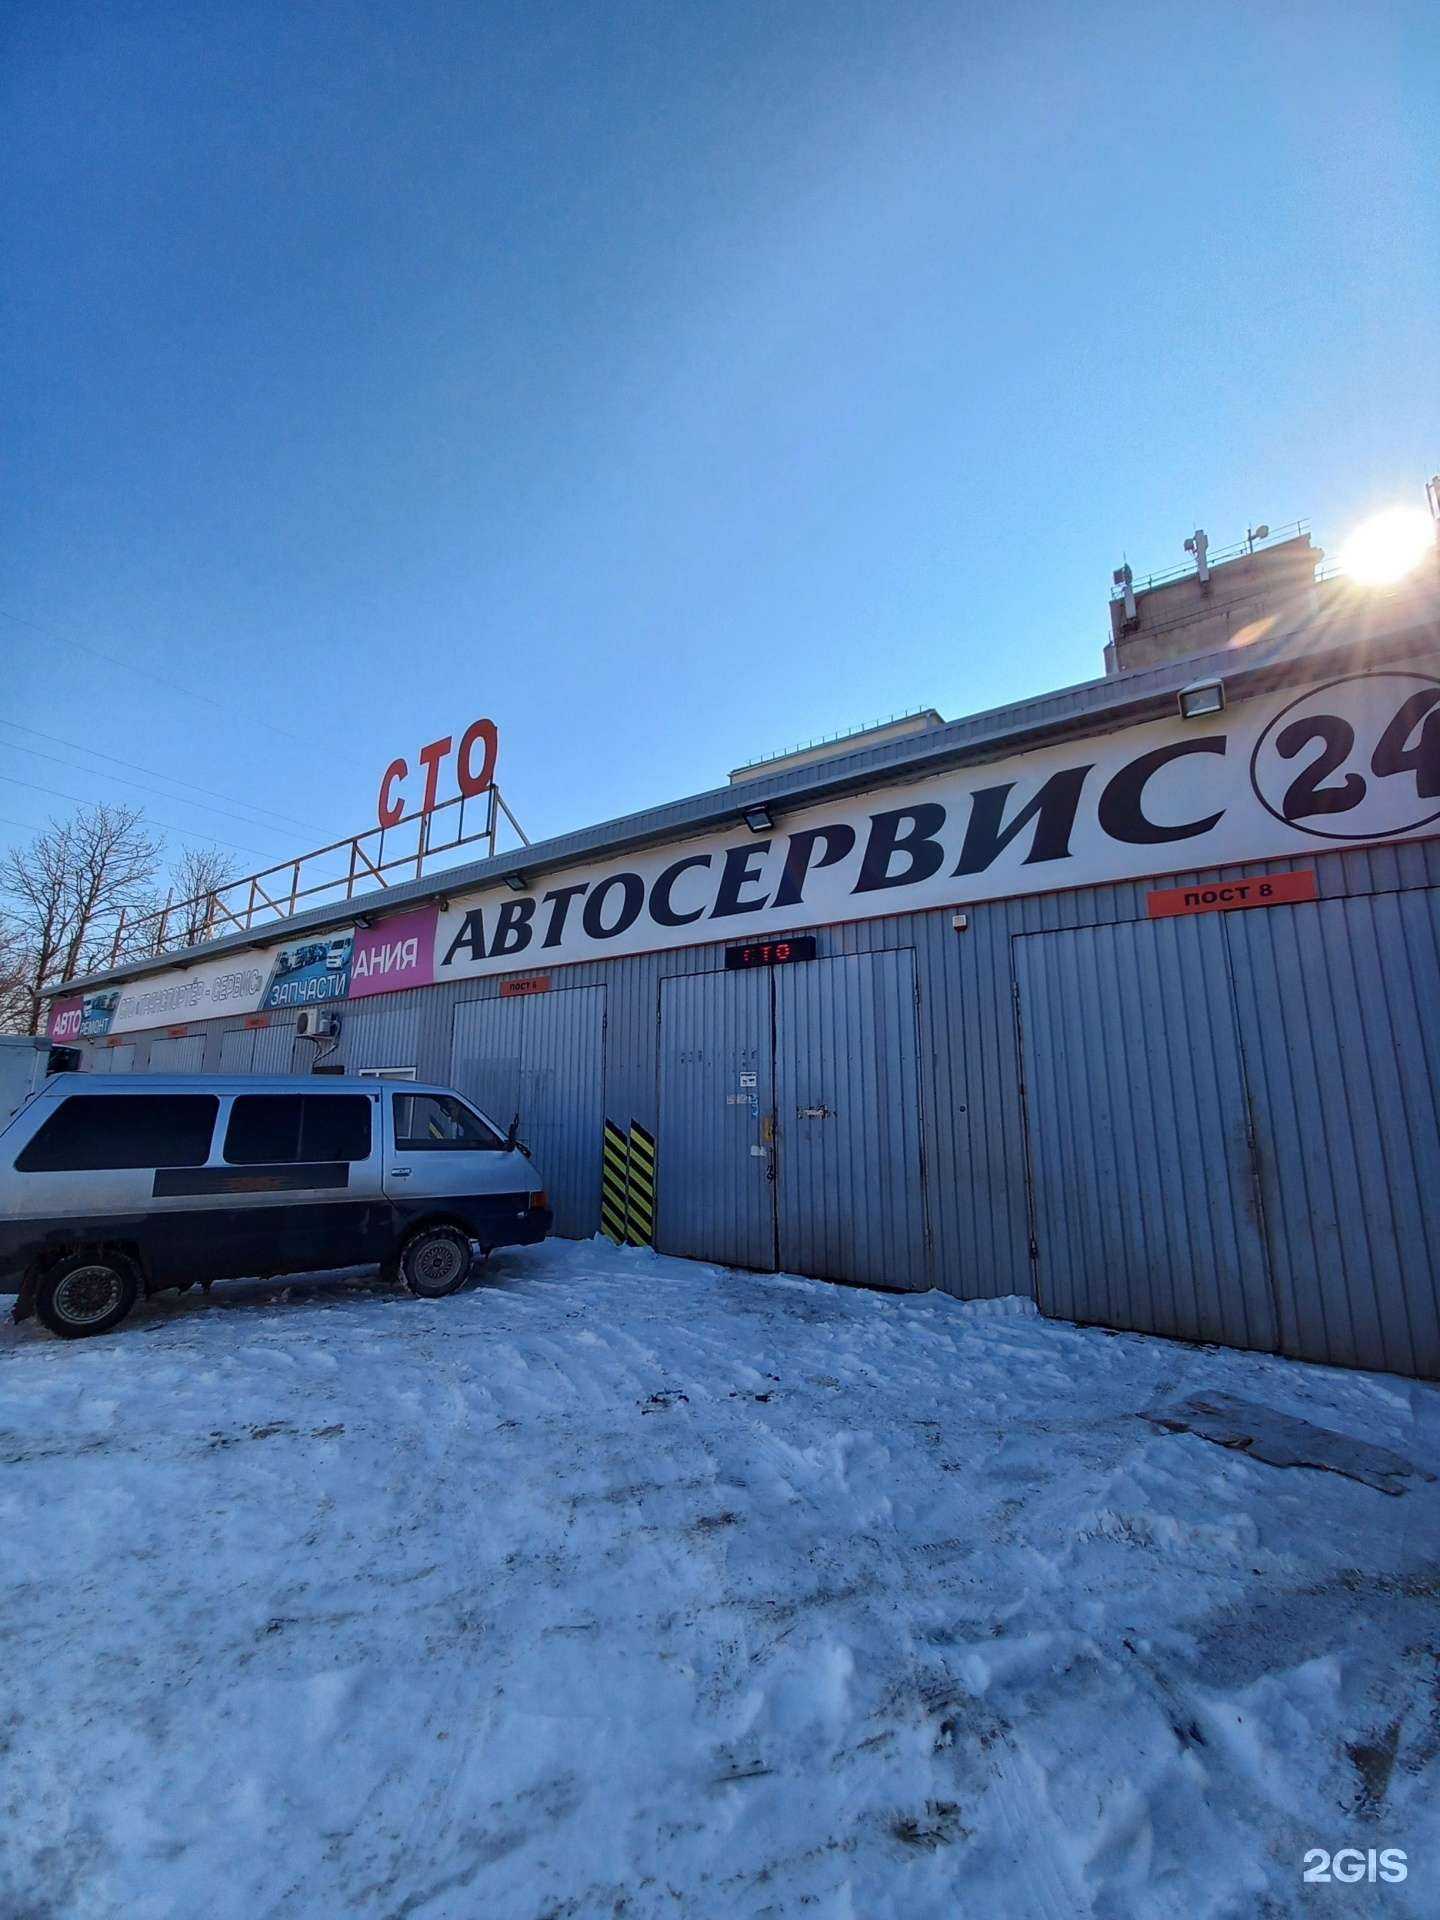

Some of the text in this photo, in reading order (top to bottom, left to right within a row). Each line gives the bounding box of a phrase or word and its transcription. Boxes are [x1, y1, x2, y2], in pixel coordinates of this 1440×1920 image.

[378, 718, 498, 829] СТО
[440, 687, 1440, 966] АВТОСЕРВИС 24
[1184, 884, 1274, 906] ПОСТ 8
[351, 937, 419, 979] АНИЯ
[270, 973, 347, 1006] ЗАПЧАСТИ
[509, 982, 530, 992] ПОСТ
[53, 1010, 82, 1035] АВТО
